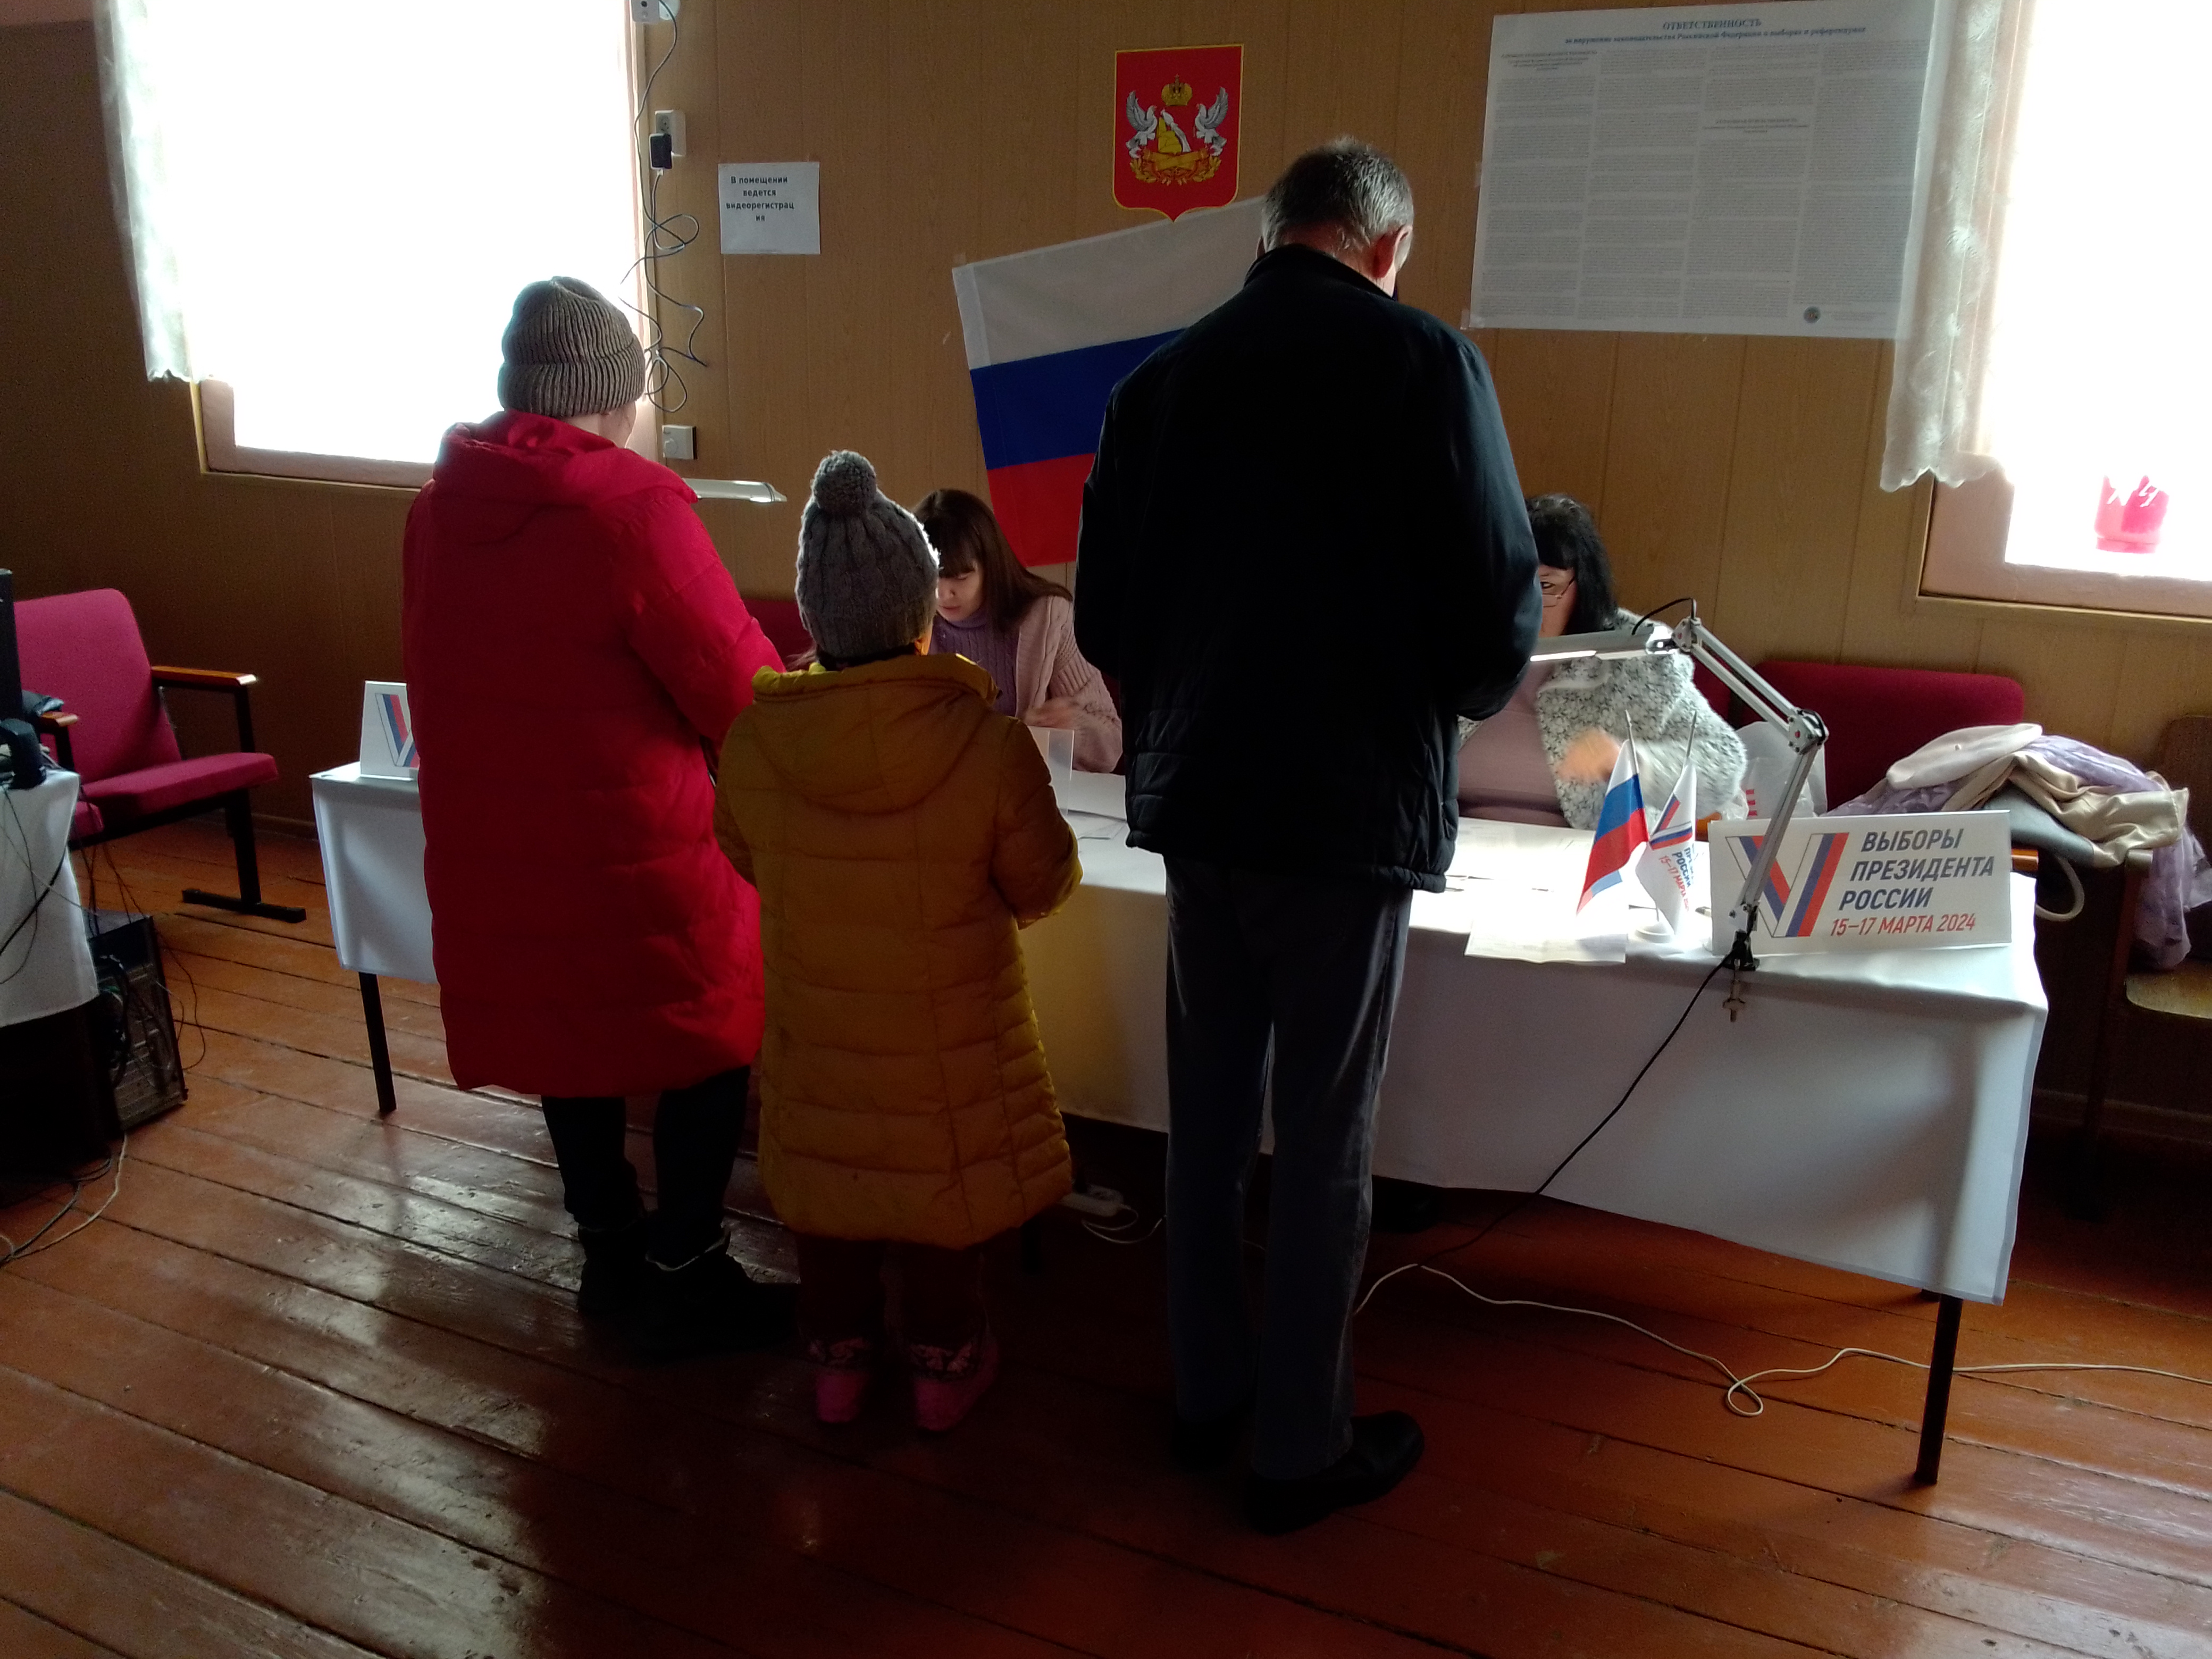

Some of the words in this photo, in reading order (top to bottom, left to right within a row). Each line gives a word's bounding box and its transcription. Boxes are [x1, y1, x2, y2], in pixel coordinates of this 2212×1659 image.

[1663, 18, 1762, 30] ОТВЕТСТВЕННОСТЬ
[726, 202, 794, 211] видеорегистрац
[1861, 828, 1965, 853] ВЫБОРЫ
[1672, 851, 1691, 887] РОССИИ
[1850, 856, 1995, 882] ПРЕЗИДЕНТА
[1673, 874, 1686, 898] МАРТА
[1838, 887, 1934, 911] РОССИИ
[1878, 915, 1933, 935] МАРТА
[1936, 913, 1976, 933] 2024
